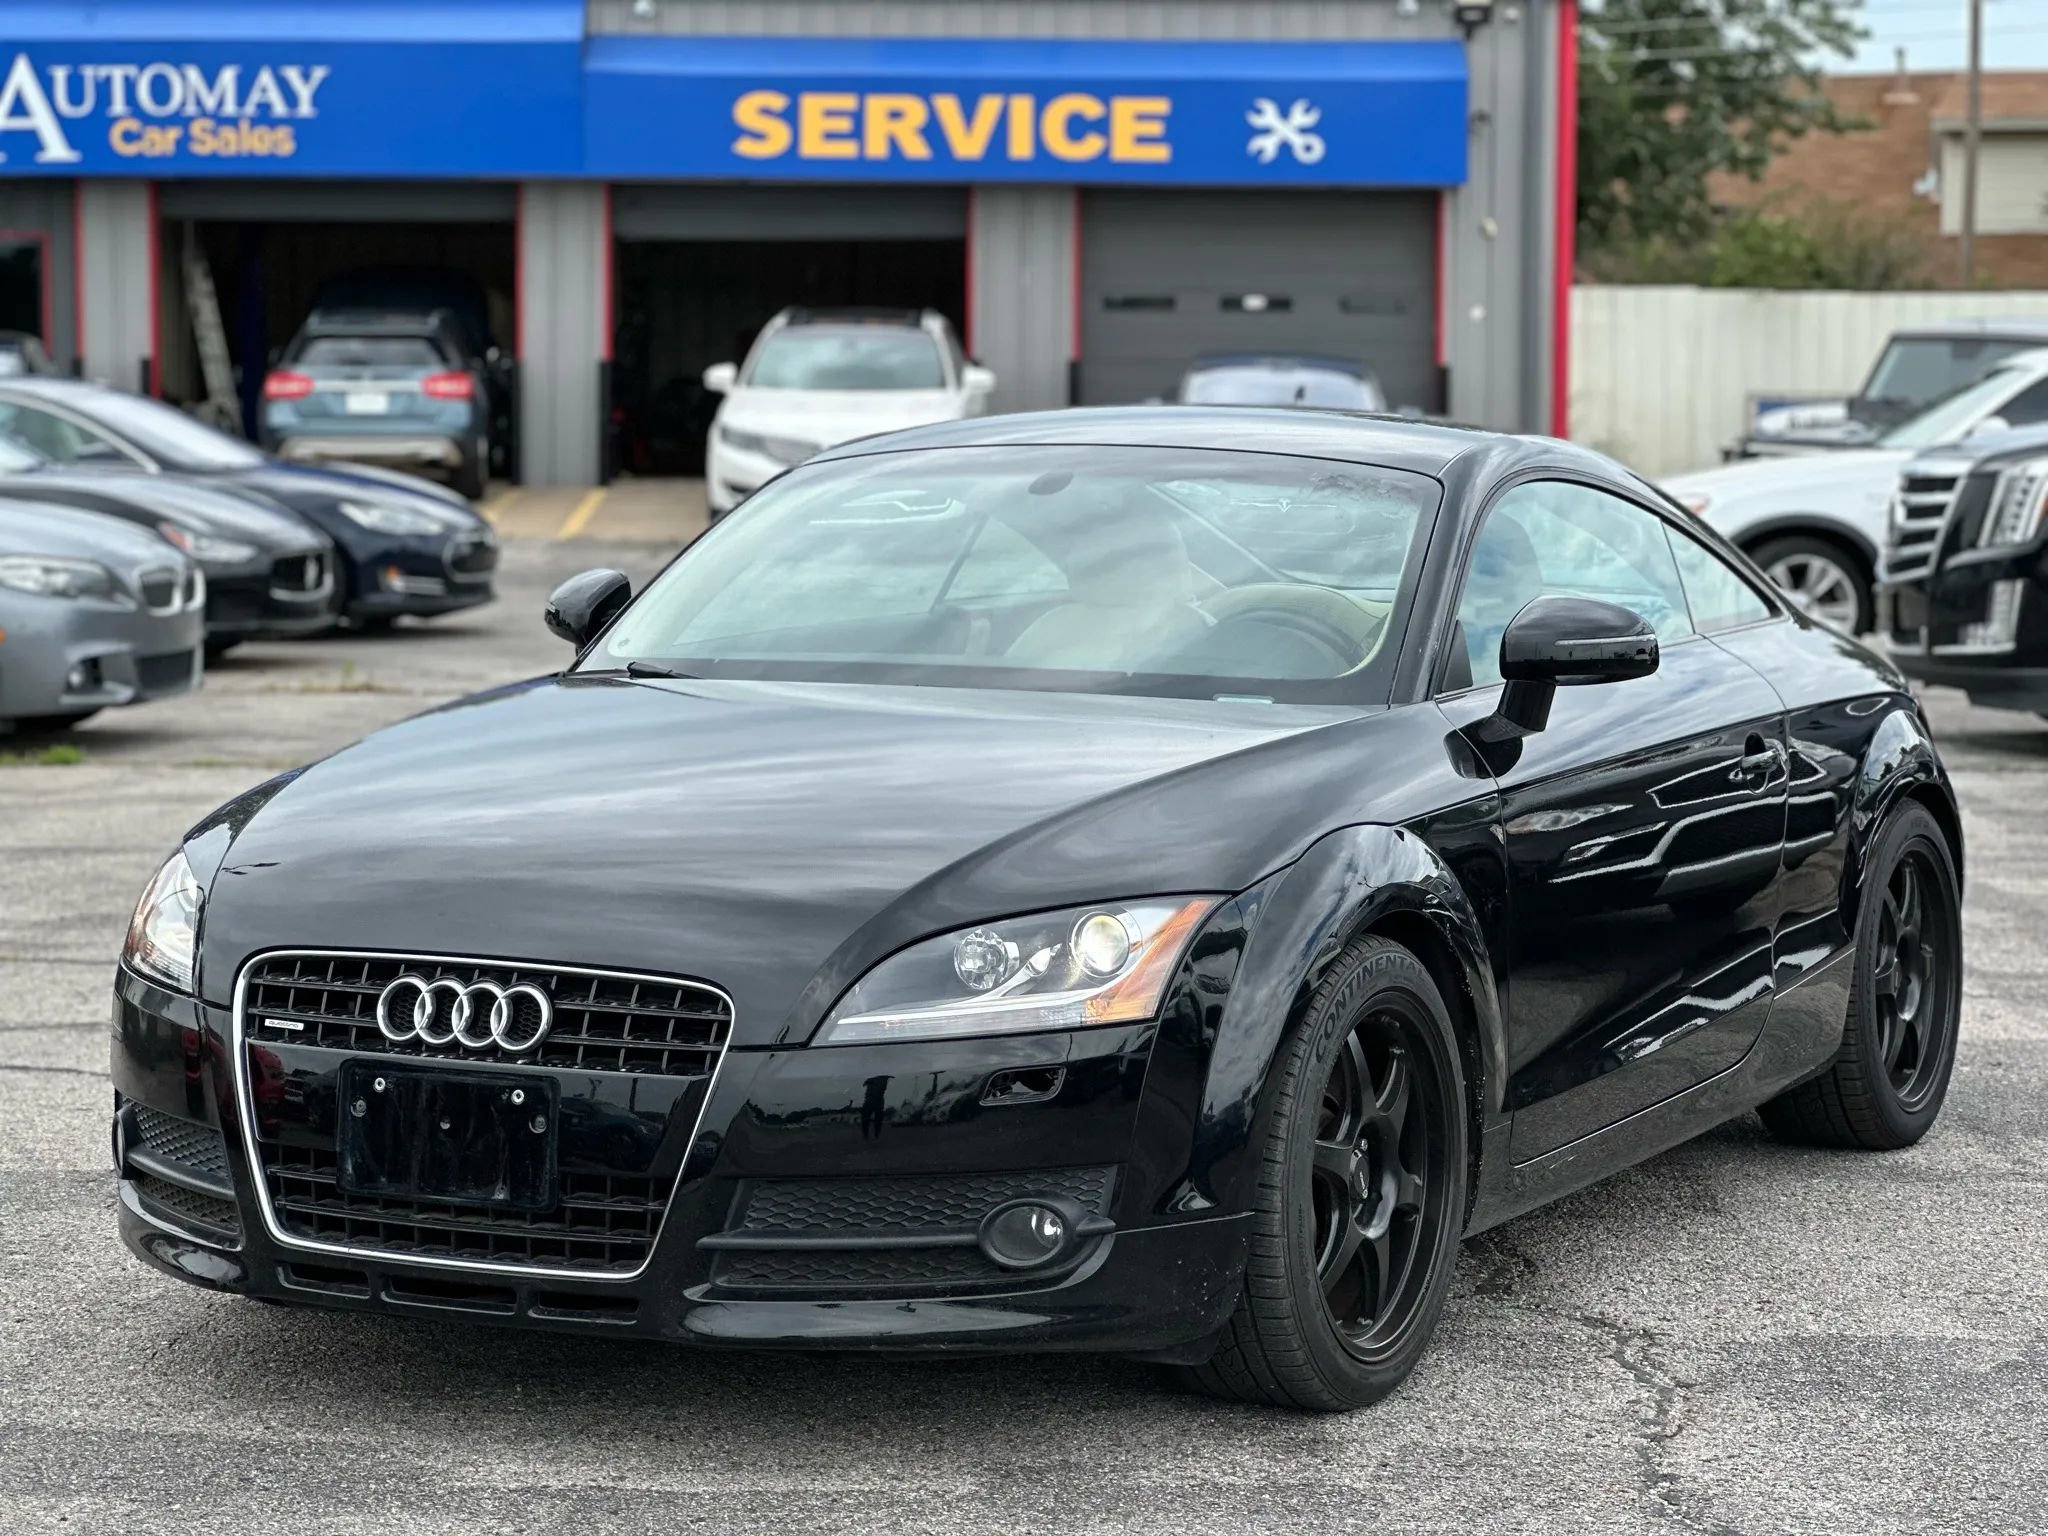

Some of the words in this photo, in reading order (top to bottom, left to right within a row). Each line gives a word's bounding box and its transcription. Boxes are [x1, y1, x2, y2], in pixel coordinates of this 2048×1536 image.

[0, 51, 330, 163] AUTOMAY
[109, 117, 183, 157] Car
[189, 116, 296, 157] Sales
[731, 90, 1172, 163] SERVICE
